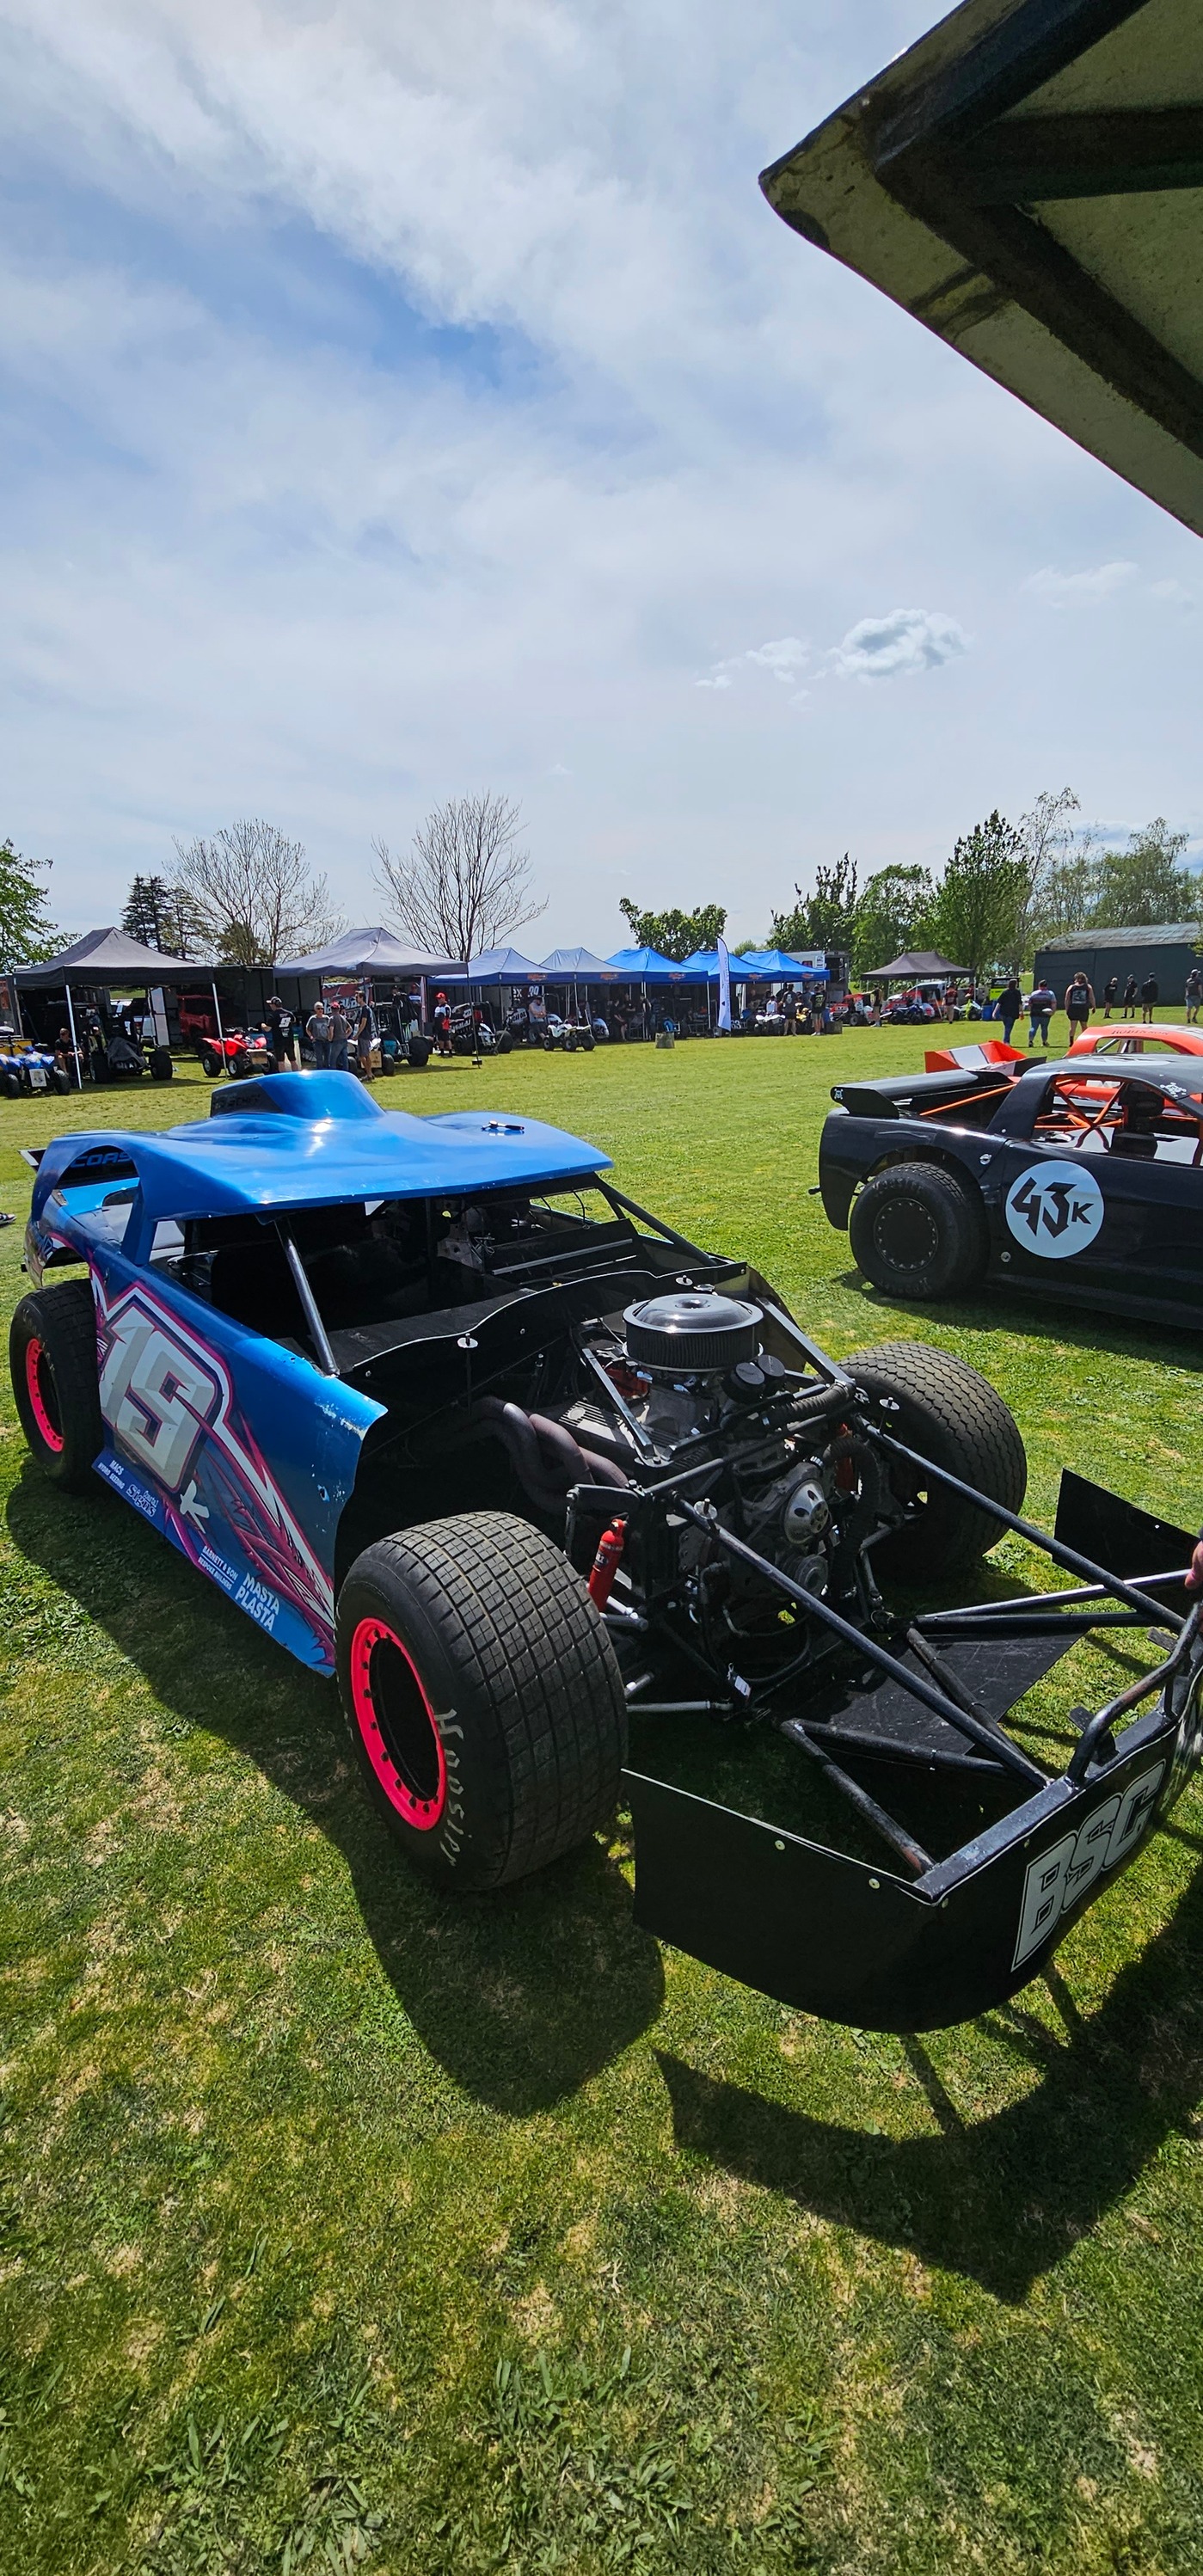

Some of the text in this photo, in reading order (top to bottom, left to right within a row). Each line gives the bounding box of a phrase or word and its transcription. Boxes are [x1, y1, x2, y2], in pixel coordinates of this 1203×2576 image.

[99, 1306, 215, 1535] 19 K
[108, 1460, 125, 1475] MACS
[126, 1484, 157, 1517] Signs
[143, 1490, 159, 1508] Coastal
[202, 1545, 224, 1567] BARNETT
[226, 1567, 239, 1581] SON
[212, 1570, 233, 1591] BUILDERS
[235, 1585, 277, 1632] PLASTA
[242, 1573, 280, 1616] MASTA
[1010, 1758, 1167, 1972] BSC
